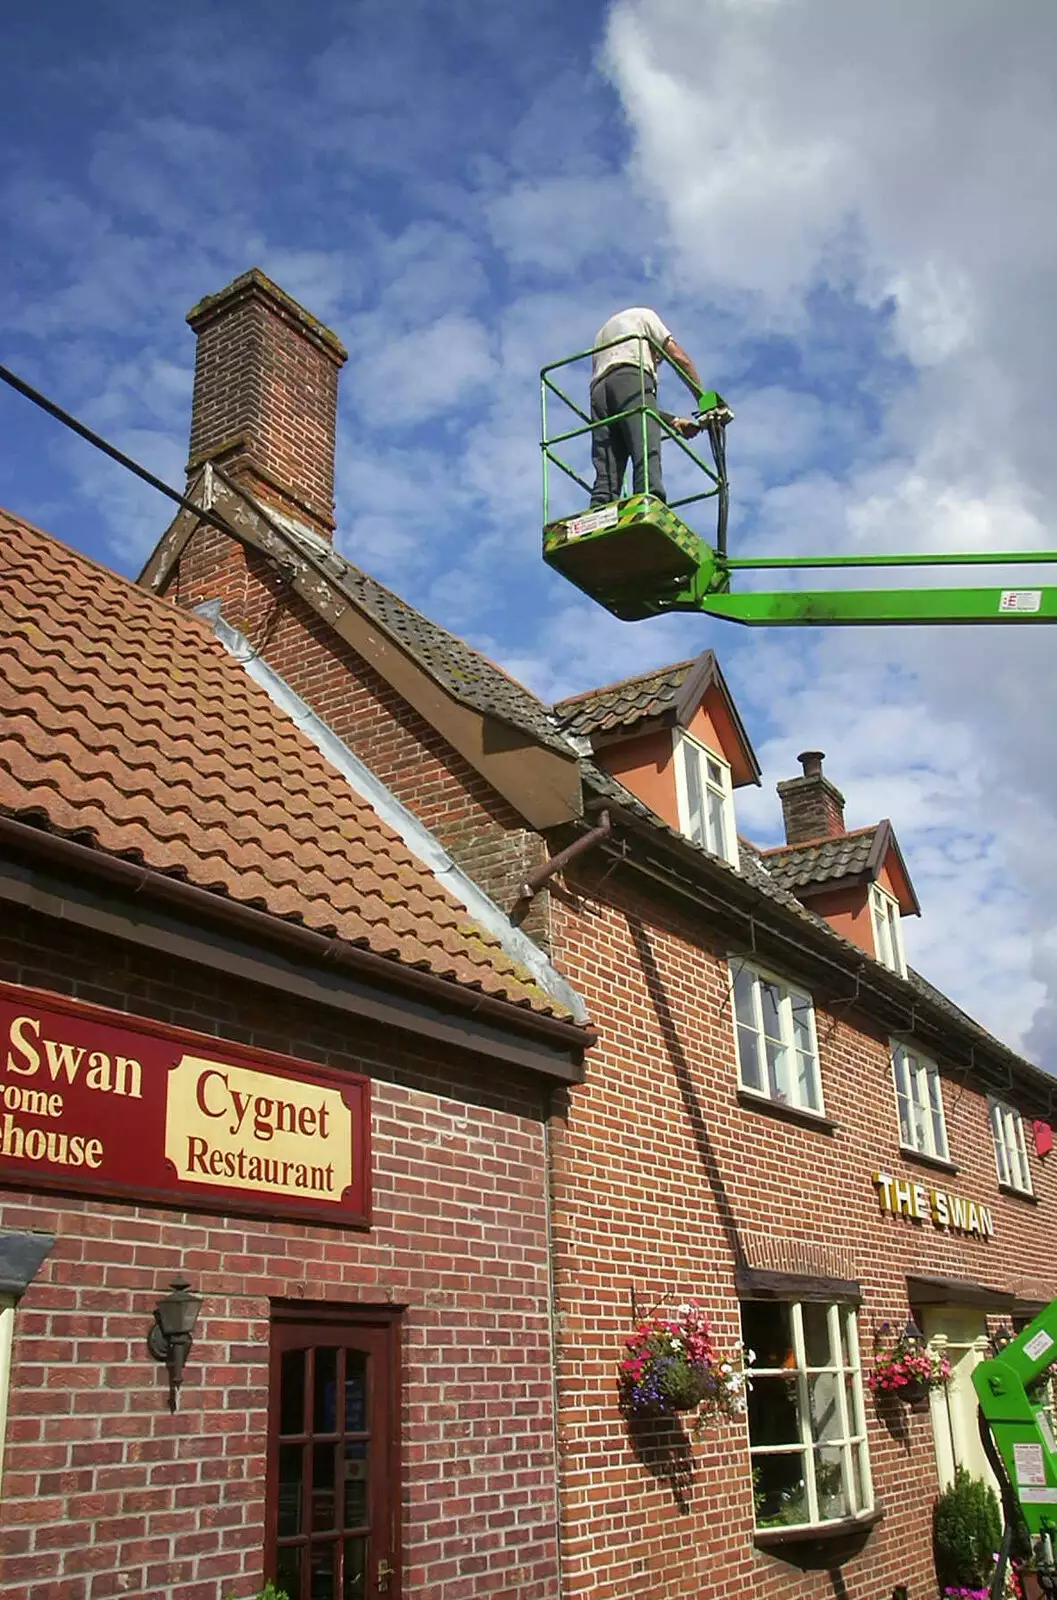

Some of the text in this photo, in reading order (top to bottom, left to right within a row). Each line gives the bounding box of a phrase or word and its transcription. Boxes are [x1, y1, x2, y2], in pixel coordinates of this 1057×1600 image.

[7, 1016, 143, 1099] Swan
[196, 1069, 330, 1141] Cygnet
[0, 1113, 103, 1168] house
[186, 1136, 335, 1192] Restaurant
[872, 1171, 994, 1236] THE SWAN
